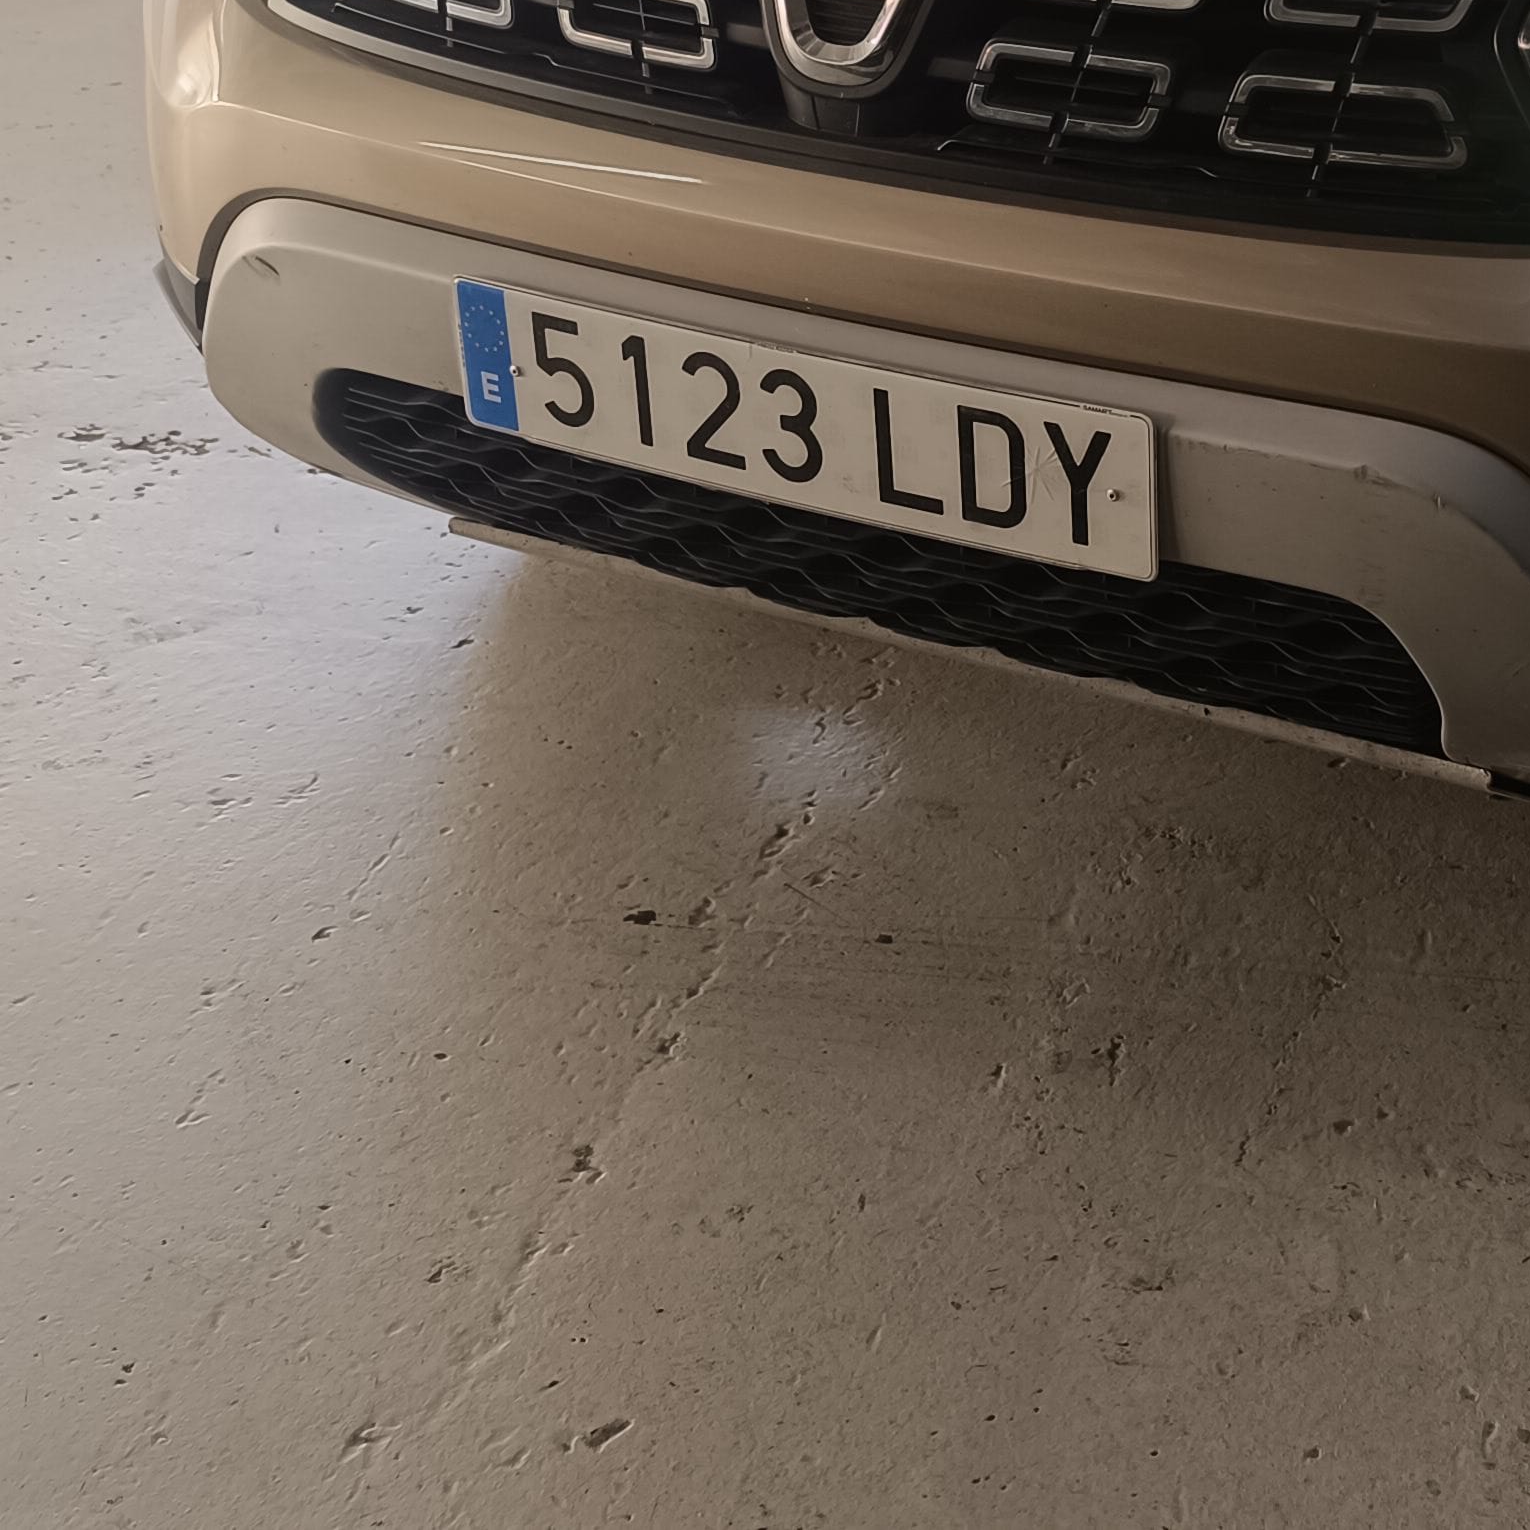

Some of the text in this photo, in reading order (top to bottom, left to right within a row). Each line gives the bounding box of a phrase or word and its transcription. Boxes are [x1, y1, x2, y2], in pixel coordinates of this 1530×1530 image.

[482, 372, 502, 404] E
[531, 311, 1112, 545] 5123 LDY
